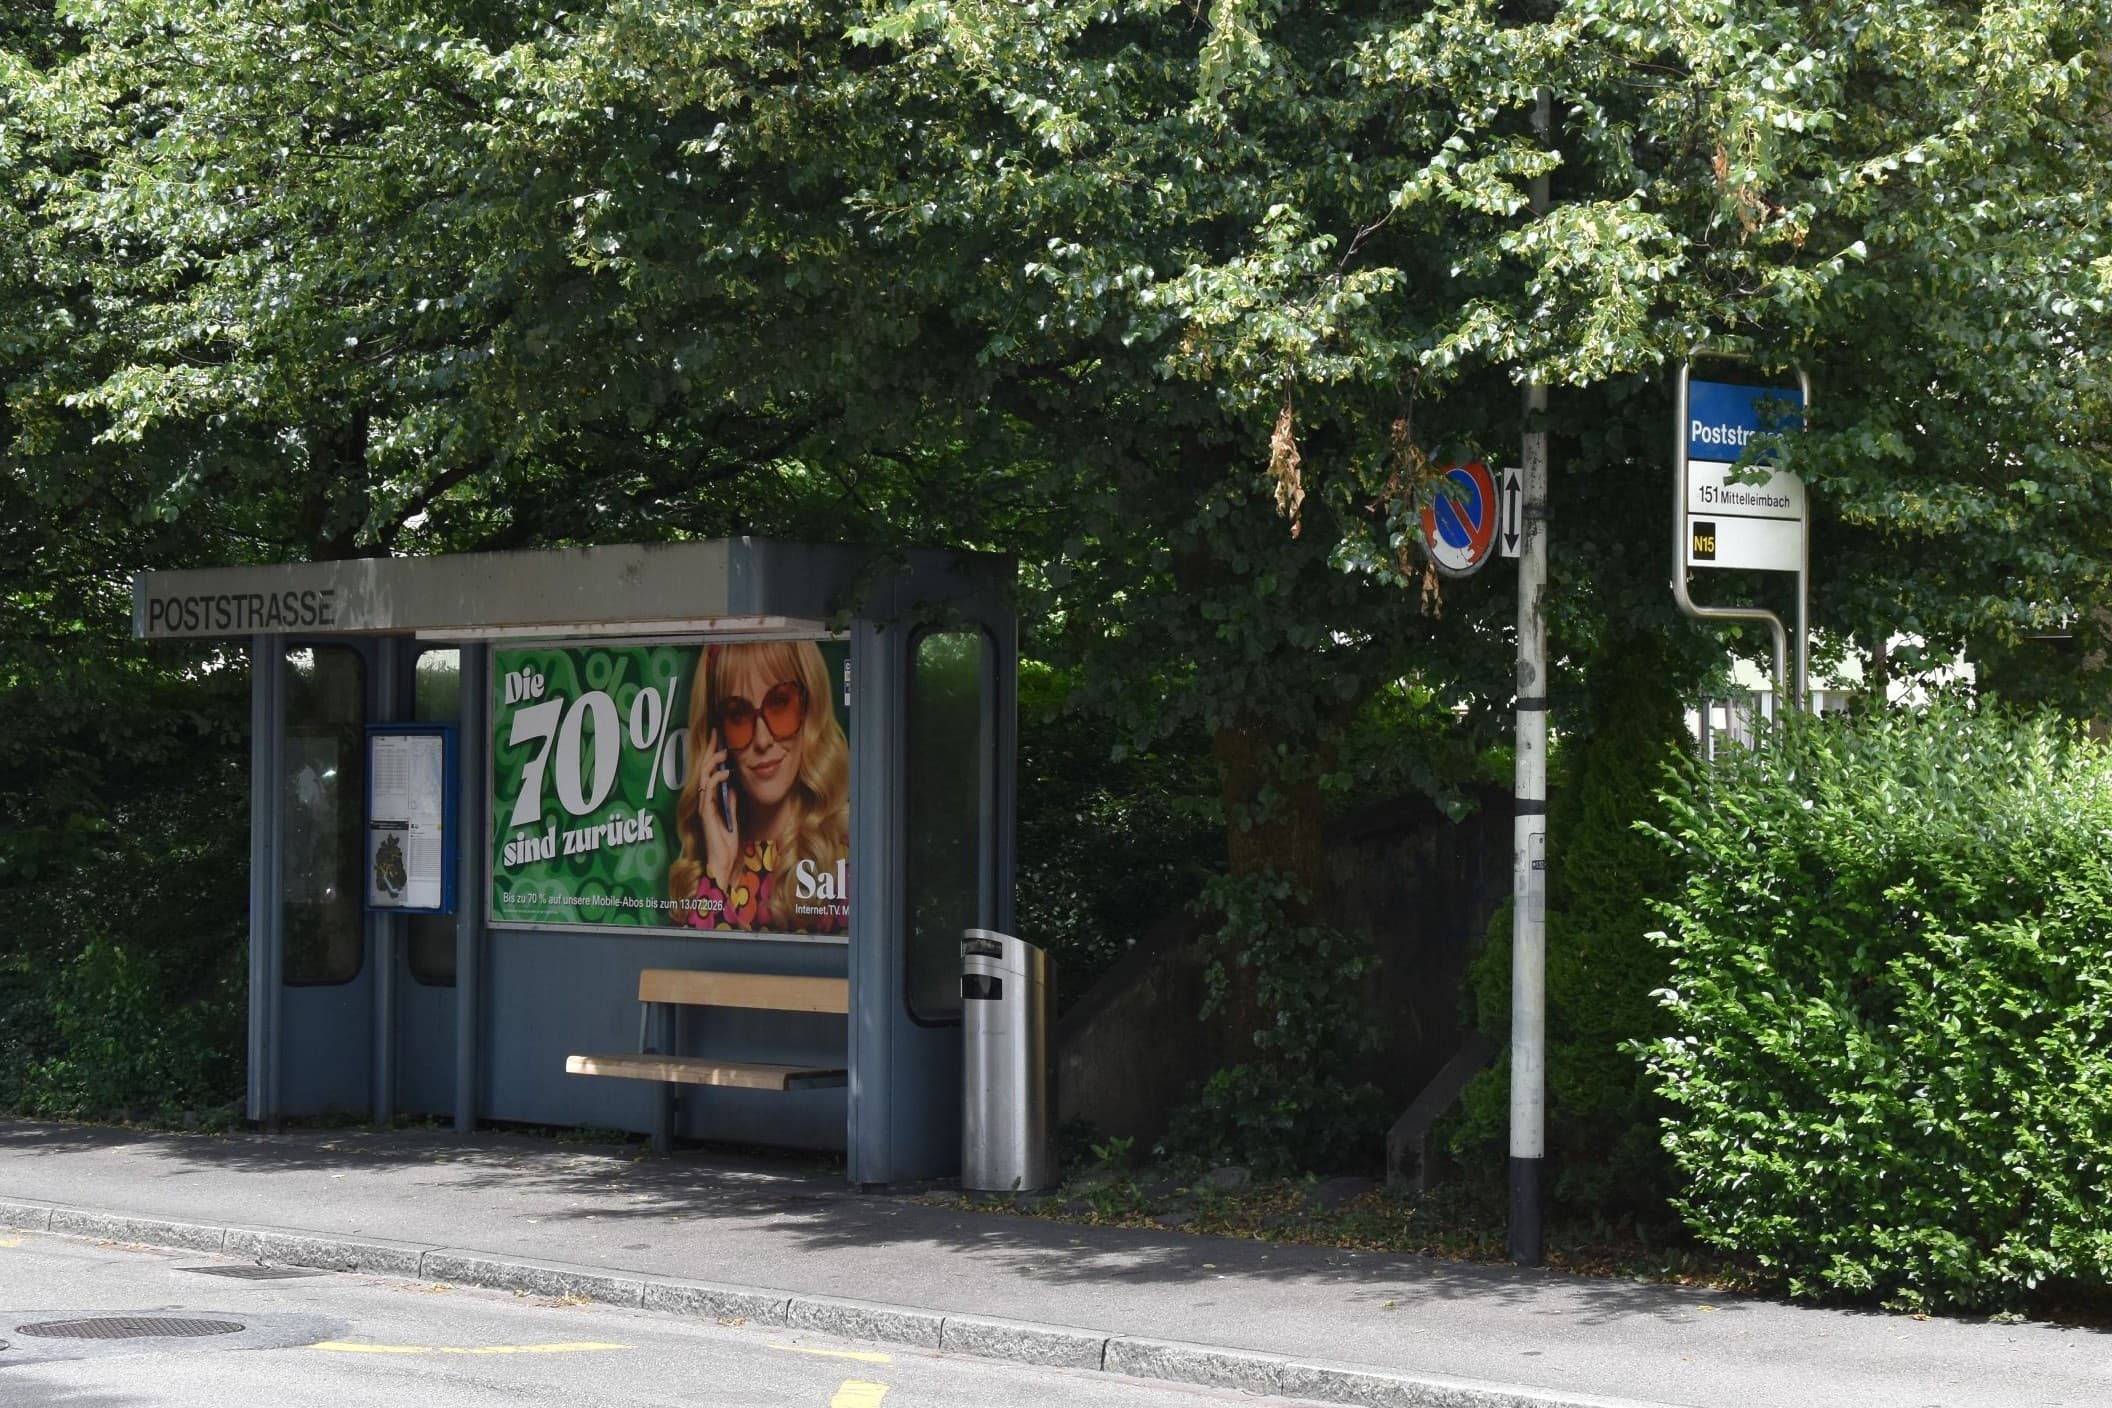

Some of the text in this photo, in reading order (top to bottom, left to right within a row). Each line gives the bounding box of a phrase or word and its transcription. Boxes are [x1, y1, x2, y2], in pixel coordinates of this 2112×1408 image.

[1692, 420, 1784, 446] Poststr
[1699, 486, 1790, 508] 151 Mittelleimbach
[1694, 535, 1715, 553] N15
[149, 590, 334, 632] POSTSTRASSE
[505, 668, 545, 705] Die
[503, 809, 654, 867] sind zurück
[796, 858, 849, 900] Sal
[503, 892, 515, 903] Bis
[516, 894, 526, 903] zu
[528, 893, 537, 904] 70
[549, 894, 561, 905] auf
[563, 896, 590, 906] unsere
[592, 895, 644, 908] Mobile-Abos
[645, 897, 658, 908] bis
[660, 900, 678, 909] zum
